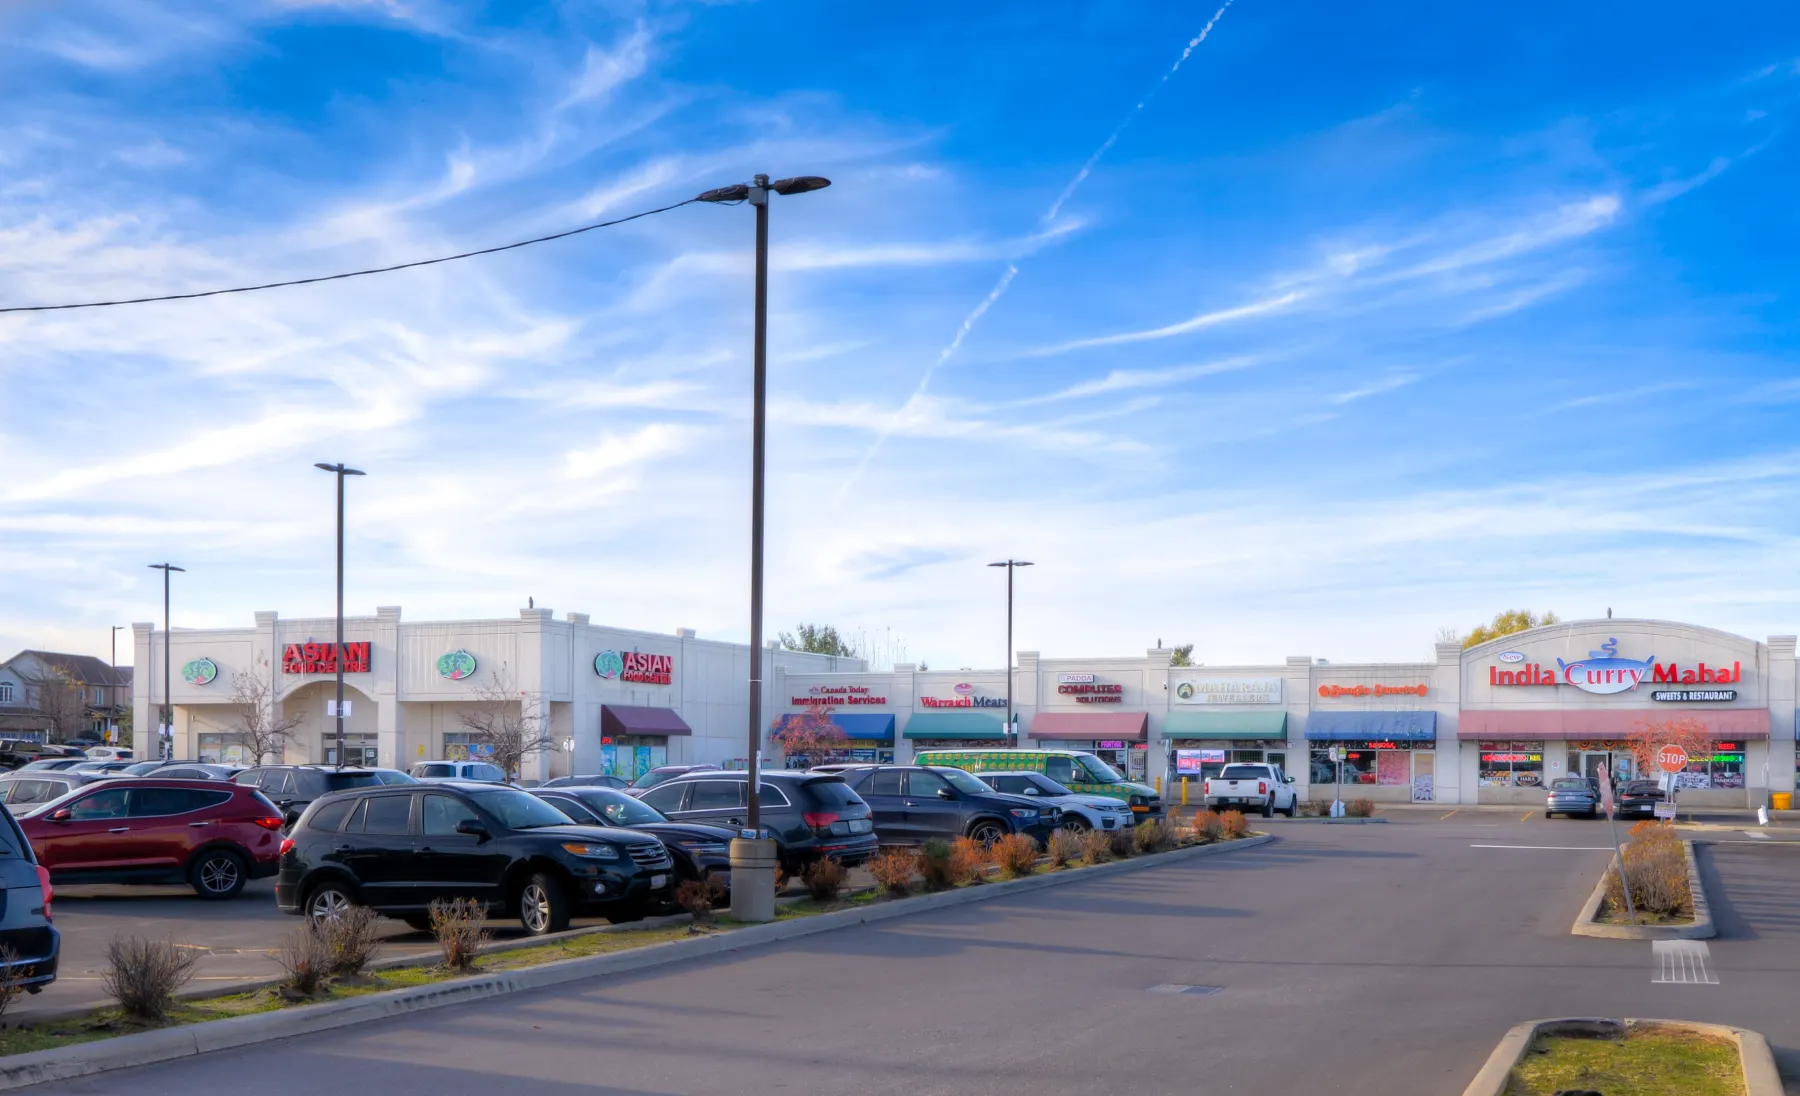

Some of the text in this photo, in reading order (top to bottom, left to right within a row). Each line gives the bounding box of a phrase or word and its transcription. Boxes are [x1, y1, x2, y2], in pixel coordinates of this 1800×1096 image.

[283, 642, 369, 661] ASIAN
[283, 661, 369, 673] FOOD CETRE
[624, 652, 673, 673] ASIAN
[623, 670, 644, 682] FOOD
[1489, 661, 1741, 691] India Curry Mahal
[820, 685, 869, 695] Canada Today
[1058, 684, 1122, 694] COMPUTER
[791, 694, 887, 706] Immigration Services
[920, 695, 1008, 708] Warraich Meats
[1655, 691, 1733, 700] SWEETS & RESTAURANT
[1659, 752, 1686, 765] STOP
